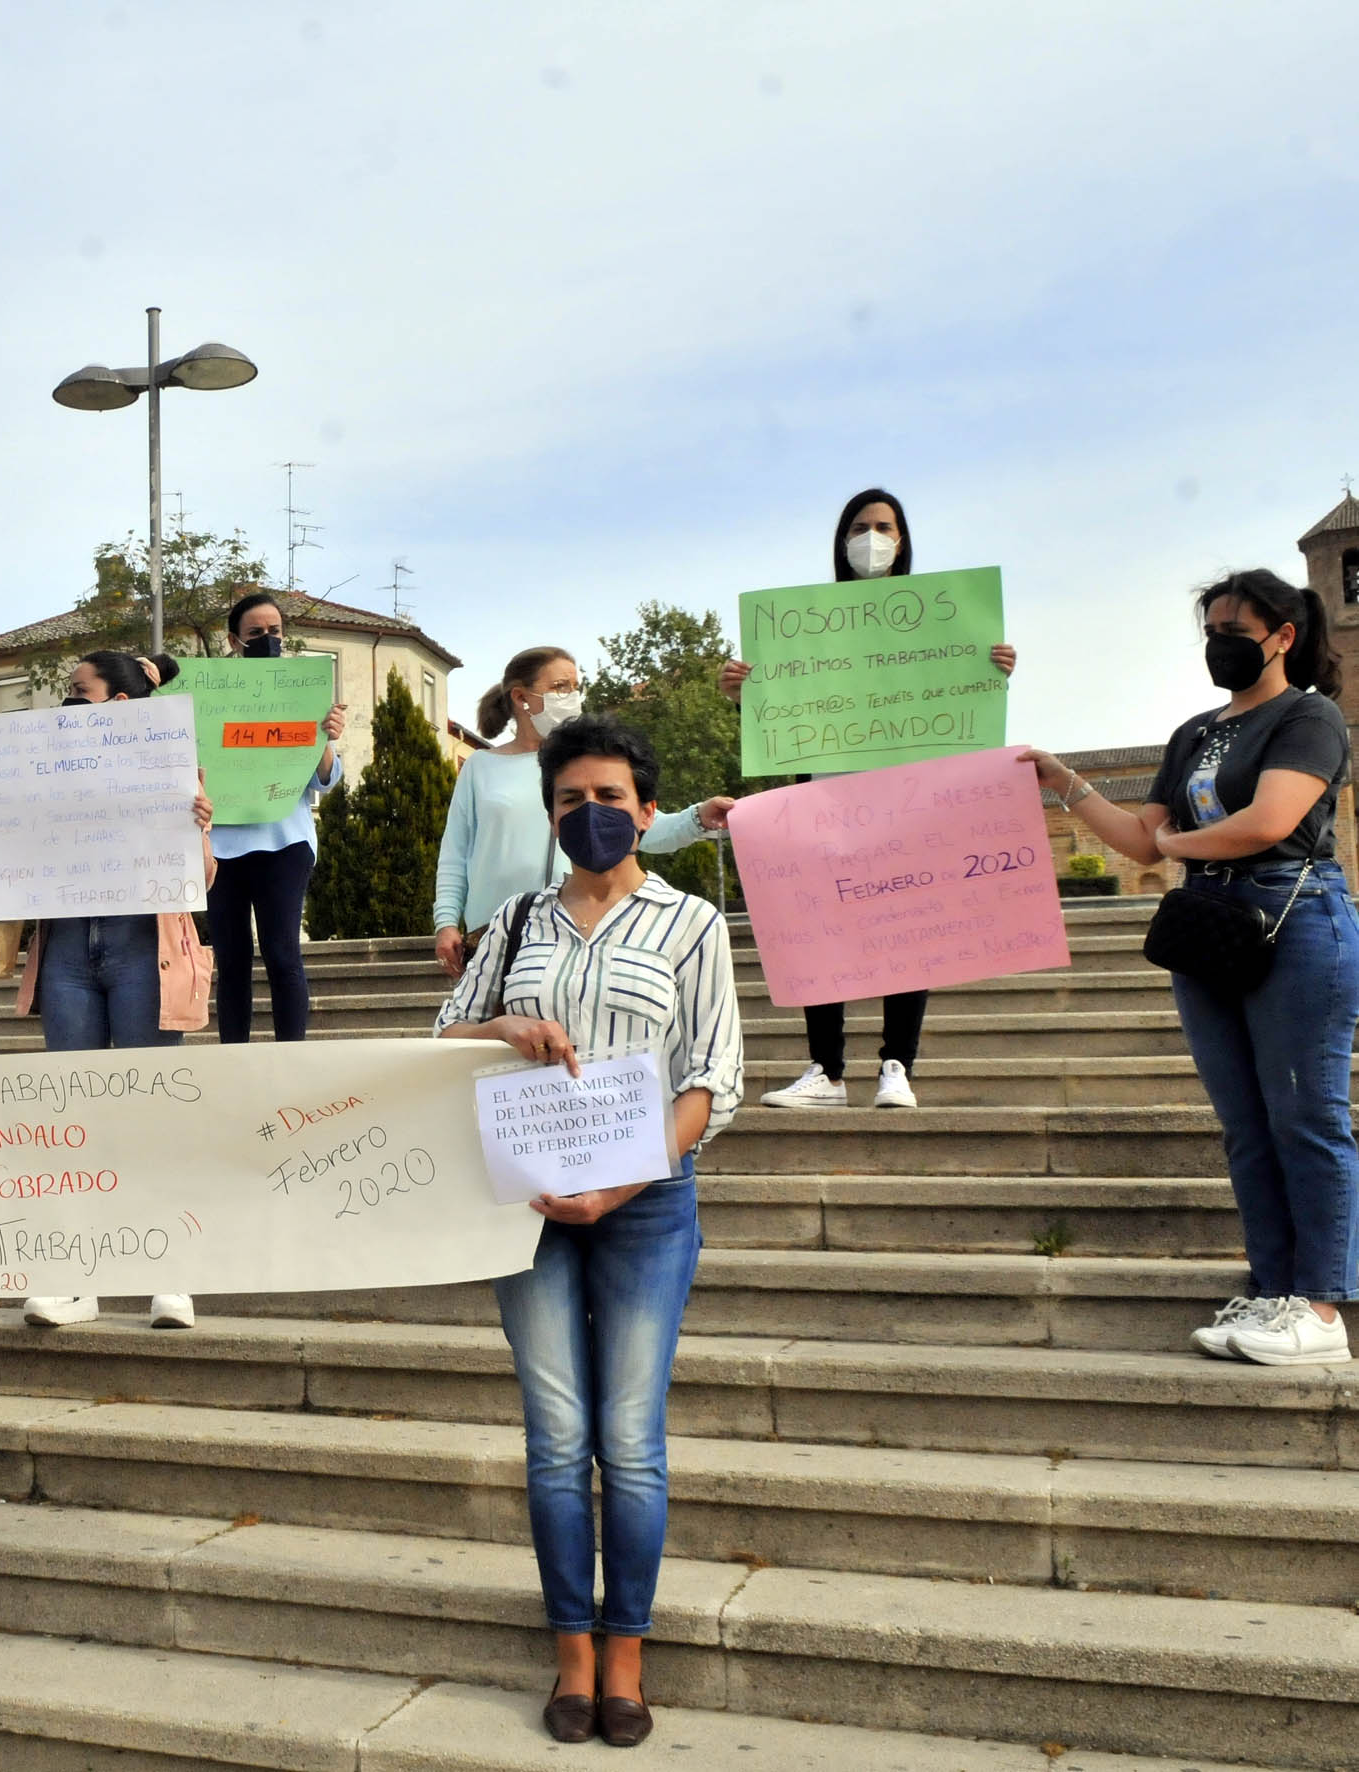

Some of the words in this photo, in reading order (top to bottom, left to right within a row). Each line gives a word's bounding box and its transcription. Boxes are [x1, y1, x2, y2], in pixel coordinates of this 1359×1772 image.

[754, 590, 957, 641] NOSOTR@S
[749, 656, 852, 684] CUMPLIMOS
[864, 643, 978, 669] TRABAJANDO
[195, 671, 246, 690] Alcalde
[252, 679, 263, 698] y
[753, 695, 856, 723] VOSOTR@S
[922, 687, 944, 700] QUE
[949, 679, 1003, 698] CUMPLIR
[230, 728, 255, 744] 14
[835, 870, 934, 903] FEBRERO
[963, 846, 1036, 879] 2020
[143, 879, 199, 905] 2020
[493, 1091, 511, 1104] EL
[518, 1070, 645, 1100] AYUNTAMIENTO
[495, 1107, 516, 1121] DE
[520, 1098, 588, 1118] LINARES
[591, 1093, 615, 1108] NO
[620, 1089, 643, 1104] ME
[496, 1127, 519, 1140] HA
[523, 1115, 587, 1137] PAGADO
[591, 1113, 611, 1127] EL
[615, 1107, 647, 1123] MES
[513, 1142, 534, 1156] DE
[539, 1132, 609, 1152] FEBRERO
[614, 1126, 635, 1141] DE
[266, 1126, 387, 1195] Febrero
[560, 1152, 592, 1168] 2020
[335, 1147, 436, 1219] 2020
